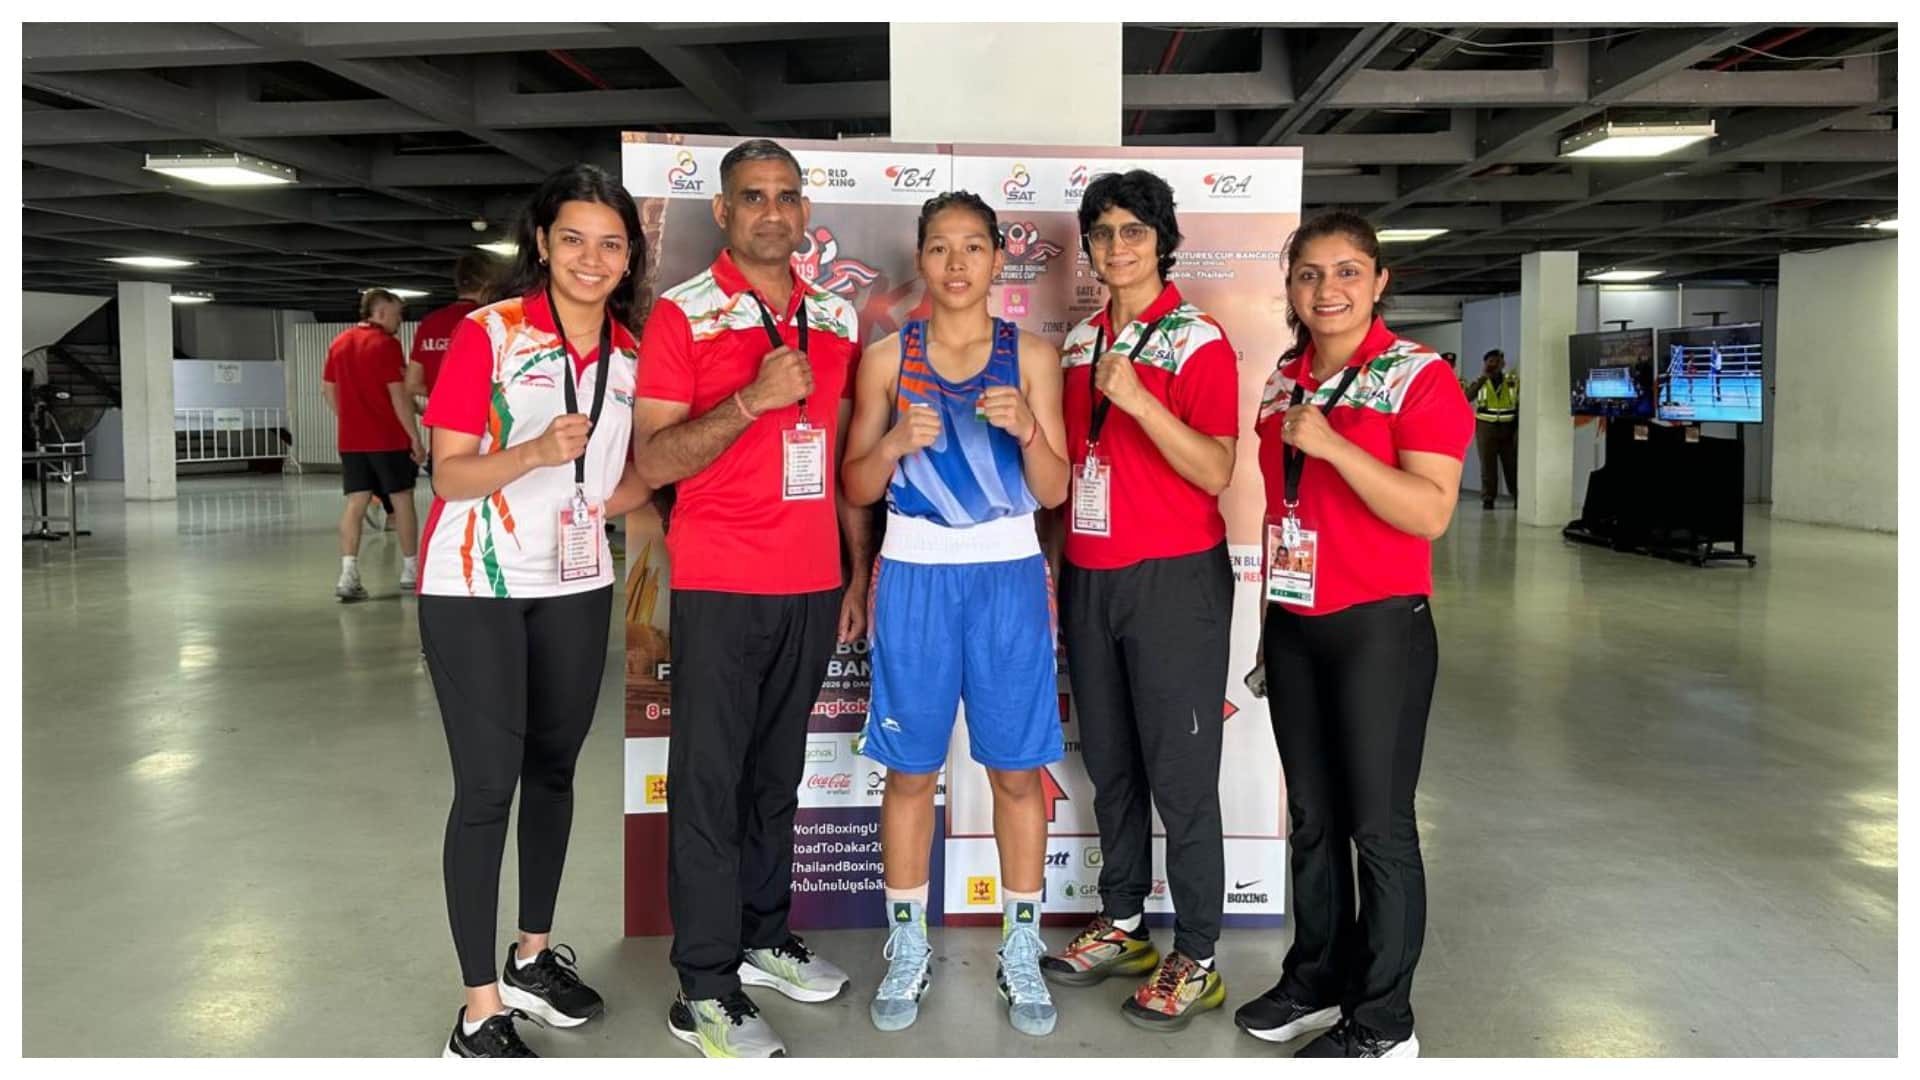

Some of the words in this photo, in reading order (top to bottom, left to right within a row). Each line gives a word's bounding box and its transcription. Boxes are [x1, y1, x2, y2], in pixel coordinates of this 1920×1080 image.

[893, 166, 936, 187] IBA
[671, 180, 704, 191] SAT
[1211, 174, 1252, 193] IBA
[1006, 190, 1036, 201] SAT
[1196, 271, 1234, 279] Thailand
[1042, 322, 1065, 333] ZONE
[1227, 892, 1268, 903] BOXING
